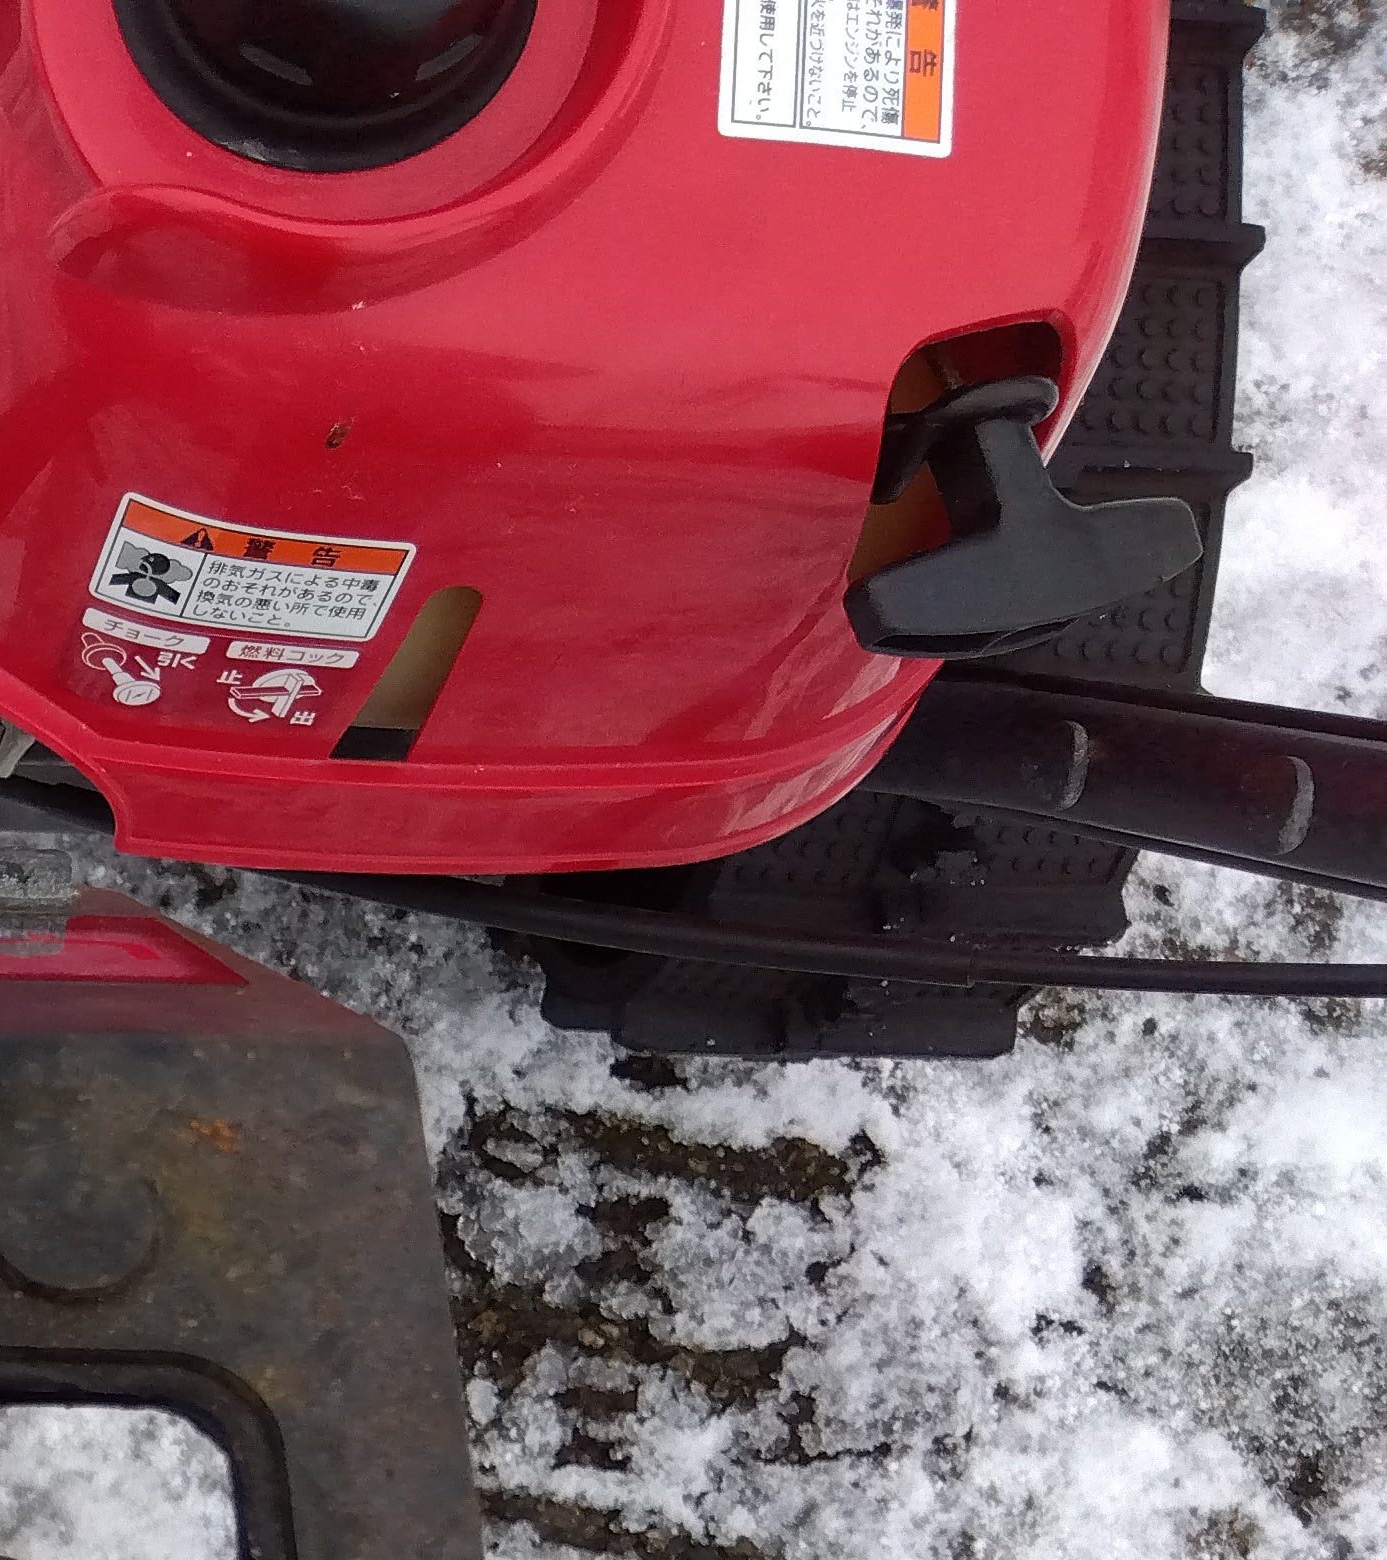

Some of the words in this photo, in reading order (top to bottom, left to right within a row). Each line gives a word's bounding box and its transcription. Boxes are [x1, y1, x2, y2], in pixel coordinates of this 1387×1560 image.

[243, 537, 342, 567] 警告
[208, 560, 381, 592] 排気ガスによる中毒
[197, 589, 367, 620] 換気の悪い所で使用
[203, 577, 378, 607] のおそれがあるので、
[192, 604, 291, 627] しないこと。
[104, 619, 185, 647] チョーク
[157, 651, 197, 669] 引く
[239, 644, 345, 664] 燃料コック
[216, 670, 243, 684] 止
[289, 711, 316, 726] 出
